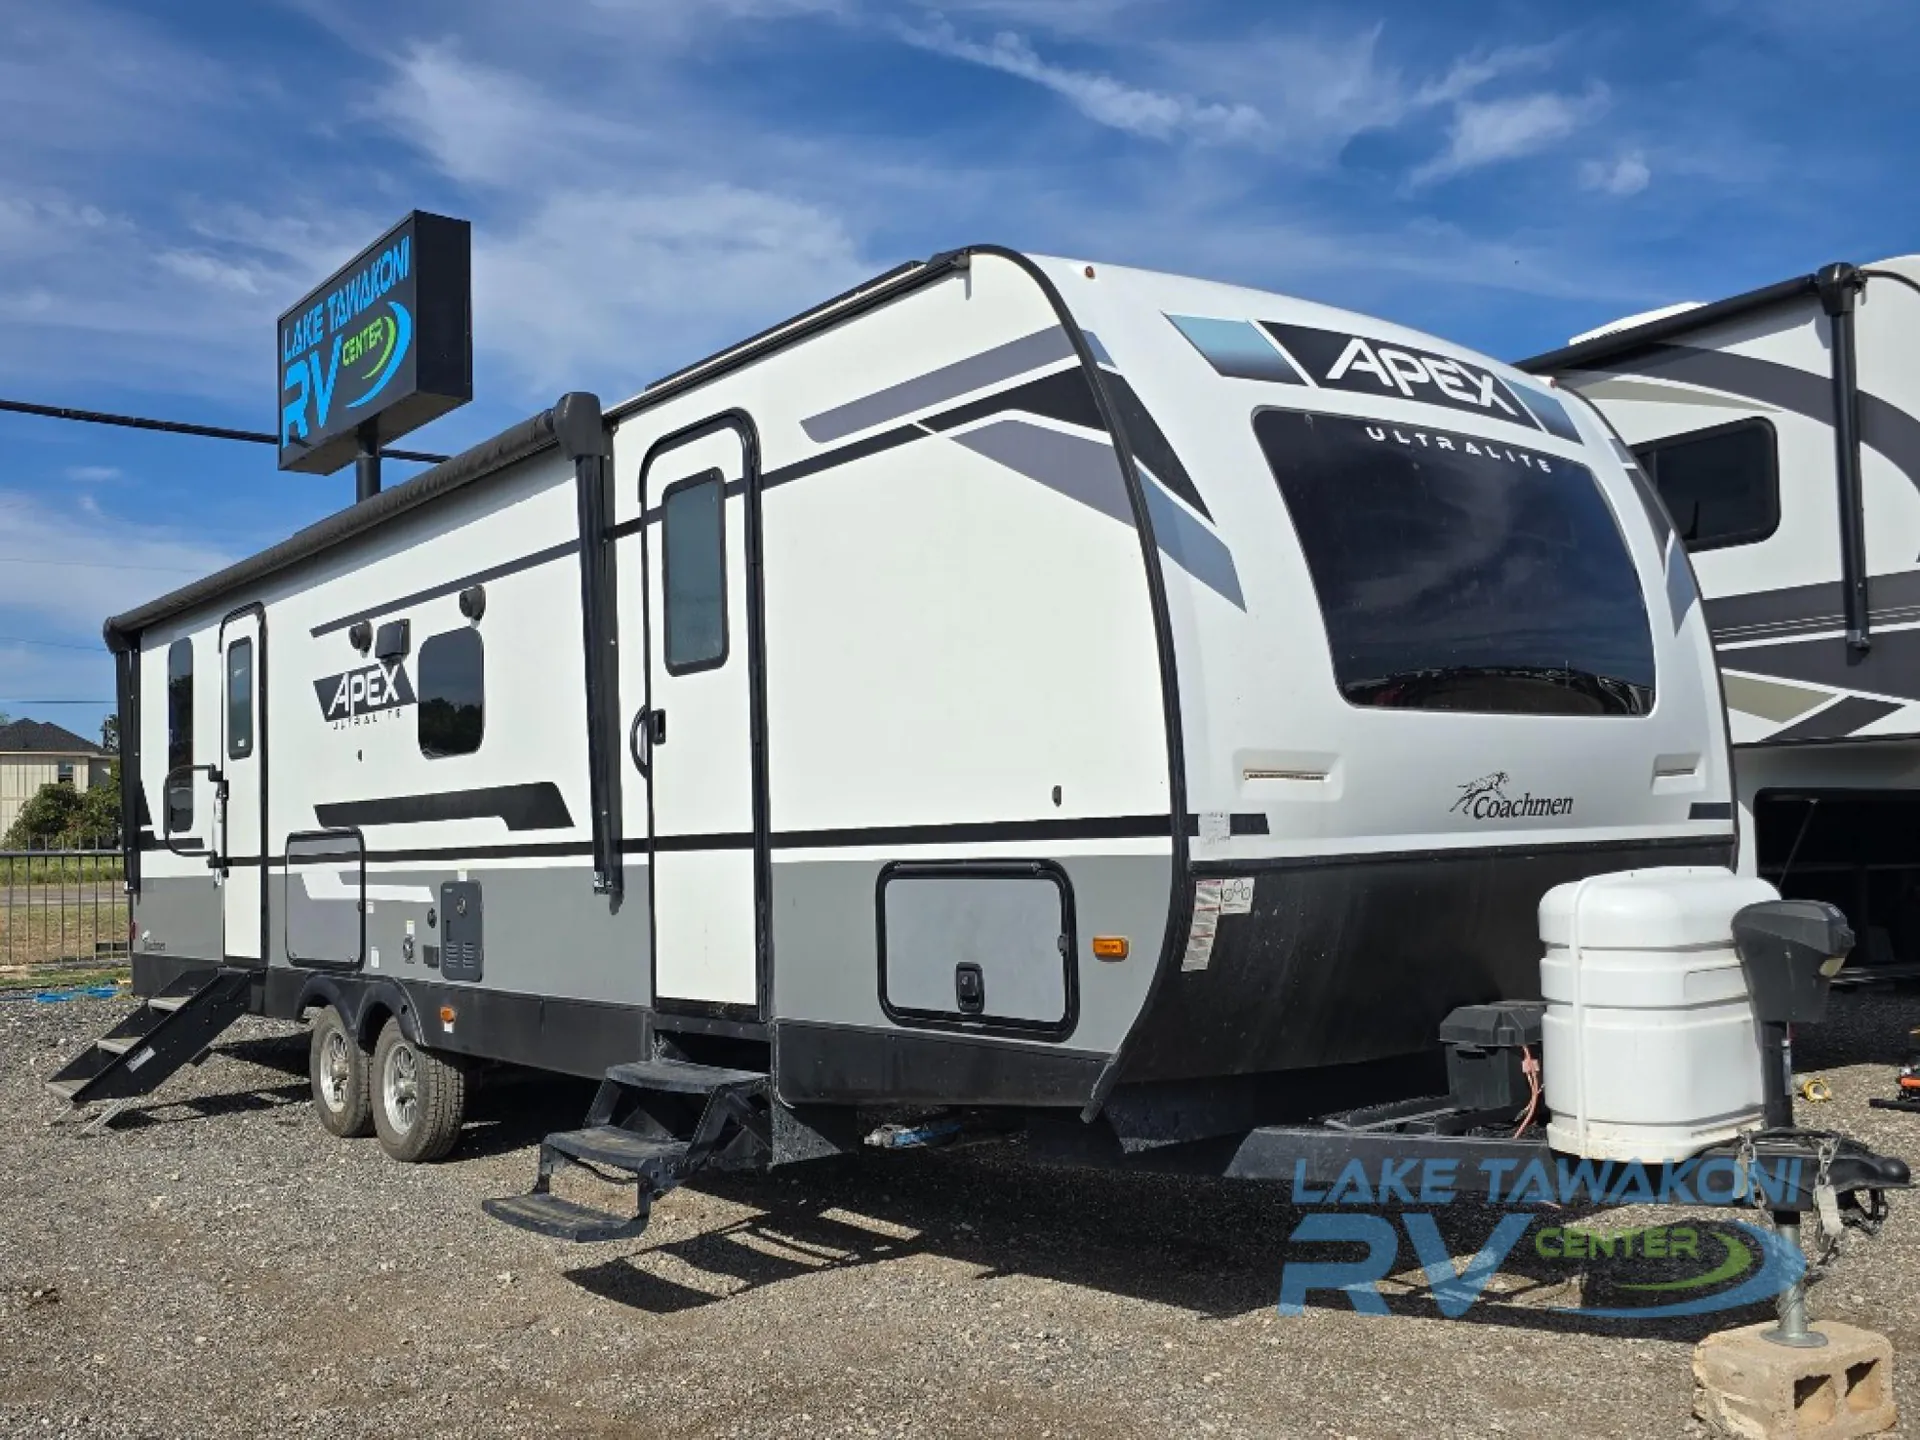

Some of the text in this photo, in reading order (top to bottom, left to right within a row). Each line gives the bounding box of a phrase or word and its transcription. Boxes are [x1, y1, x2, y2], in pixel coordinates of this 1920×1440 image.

[284, 235, 410, 363] LAKE TAWAKONI
[282, 317, 384, 449] RV CENTER
[1326, 337, 1519, 417] APEX
[1366, 426, 1552, 474] ULTRALITE
[328, 662, 400, 717] APEX
[333, 708, 401, 731] ULTRALTE
[1473, 792, 1574, 820] Coachmen
